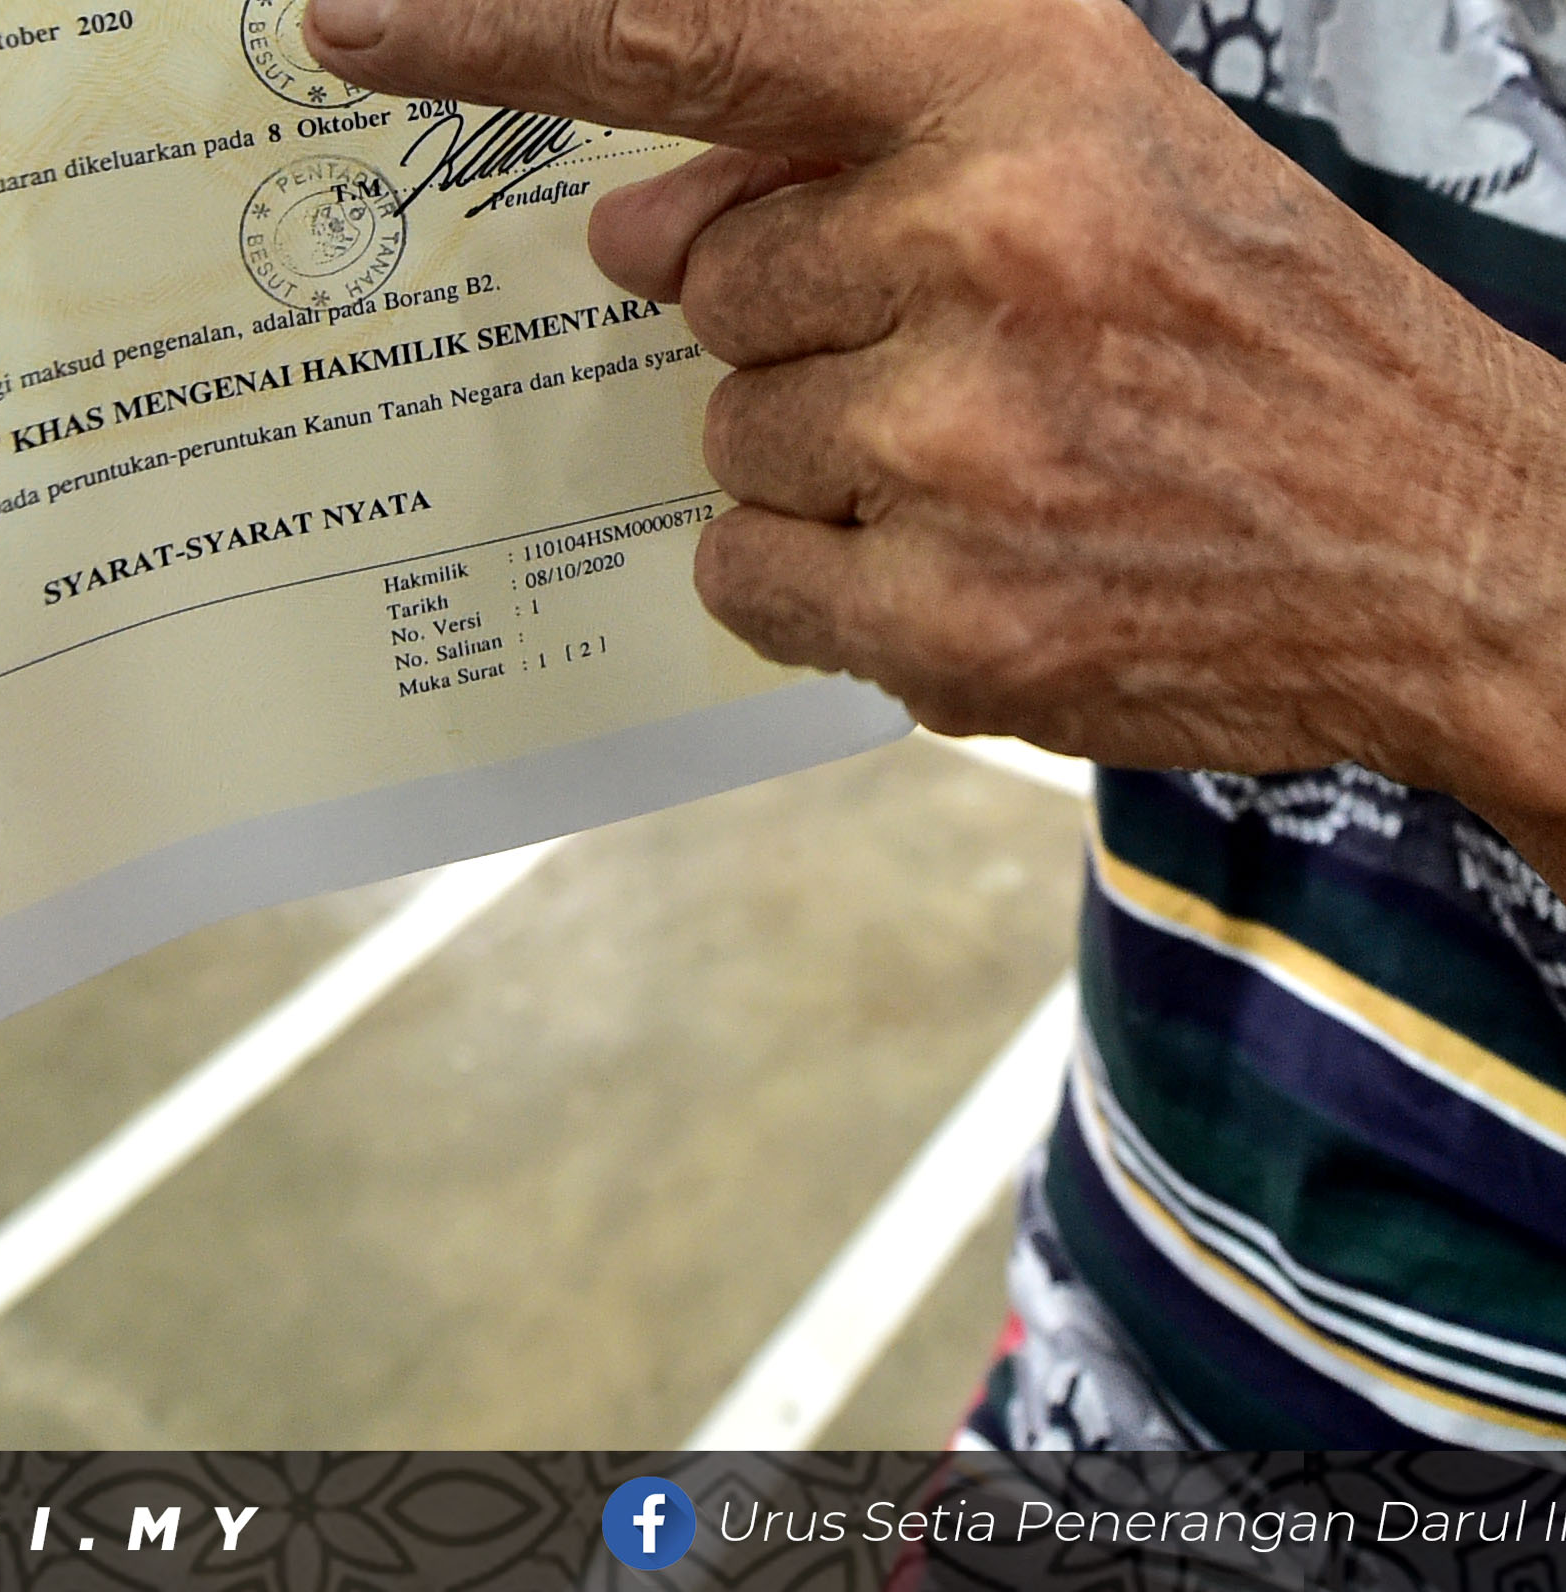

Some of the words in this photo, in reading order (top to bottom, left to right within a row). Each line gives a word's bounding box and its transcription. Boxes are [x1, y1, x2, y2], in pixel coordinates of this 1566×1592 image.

[75, 7, 134, 38] 2020
[248, 19, 295, 92] BESUT
[63, 137, 198, 181] dikeluarkan
[202, 128, 257, 159] pada
[267, 121, 283, 145] 8
[296, 107, 393, 141] Oktober
[405, 98, 459, 123] 2020
[489, 177, 591, 210] Pendaftar
[246, 233, 298, 299] BESUT
[20, 350, 106, 389] maksud
[112, 321, 244, 369] pengenalan,
[252, 304, 320, 336] adalah
[327, 295, 378, 326] pada
[384, 283, 461, 317] Borang
[465, 273, 502, 301] B2.
[11, 404, 106, 454] KHAS
[113, 366, 294, 426] MENGENAI
[301, 330, 473, 385] HAKMILIK
[476, 298, 663, 352] SEMENTARA
[47, 421, 298, 506] peruntukan-peruntukan
[303, 405, 373, 437] Kanun
[377, 393, 444, 425] Tanah
[450, 377, 523, 414] Negara
[529, 367, 566, 394] dan
[571, 352, 639, 388] kepada
[43, 505, 312, 607] SYARAT-SYARAT
[322, 487, 433, 532] NYATA
[382, 561, 470, 595] Hakmilik
[522, 504, 714, 563] 110104HSM00008712
[386, 594, 449, 622] Tarikh
[524, 550, 626, 590] 08/10/2020
[390, 627, 426, 647] No.
[433, 610, 483, 636] Versi
[394, 653, 429, 672] No.
[435, 636, 504, 663] Salinan
[398, 674, 452, 698] Muka
[457, 661, 506, 686] Surat
